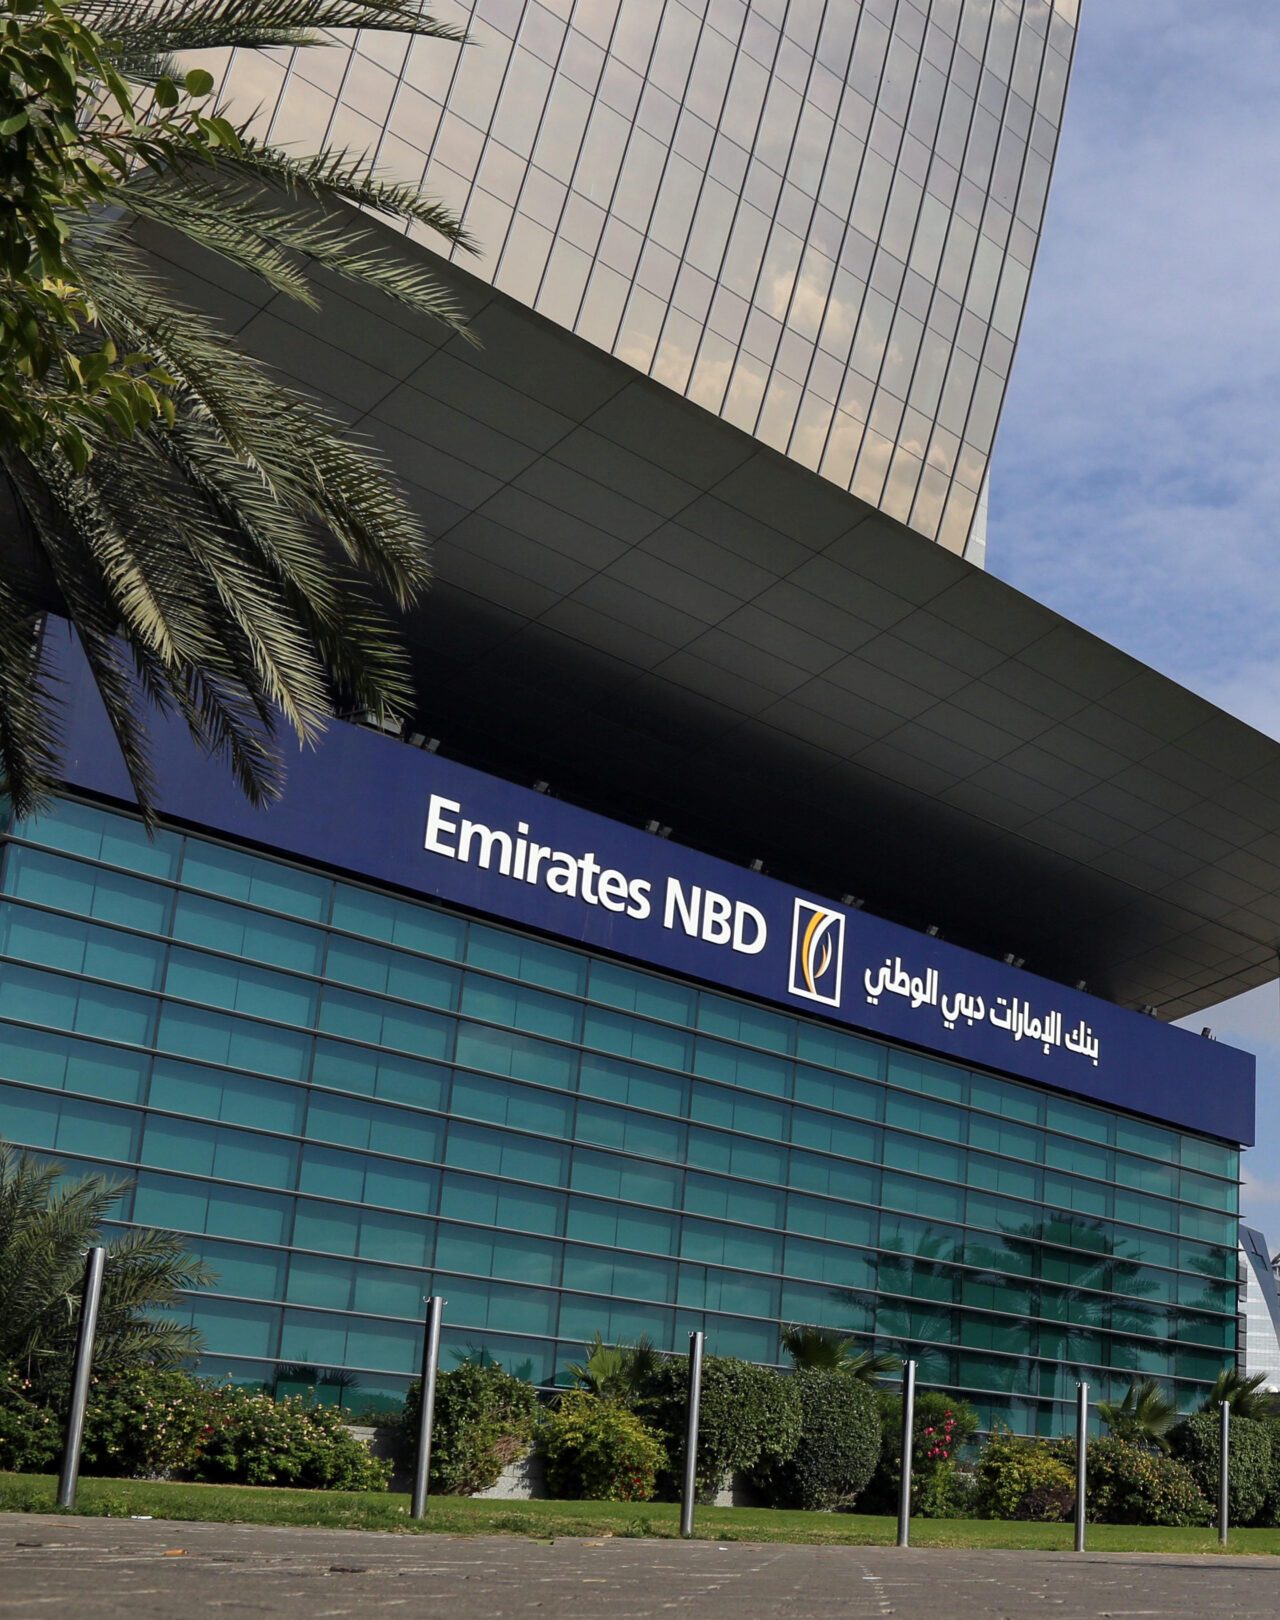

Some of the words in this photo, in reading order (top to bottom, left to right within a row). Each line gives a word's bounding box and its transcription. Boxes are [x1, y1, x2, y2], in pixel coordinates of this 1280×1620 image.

[424, 793, 652, 920] Emirates
[663, 876, 768, 955] NBD
[864, 956, 939, 1009] الوطني
[941, 992, 986, 1030] دبي
[989, 996, 1062, 1055] الإمارات
[1064, 1019, 1099, 1067] بنك
